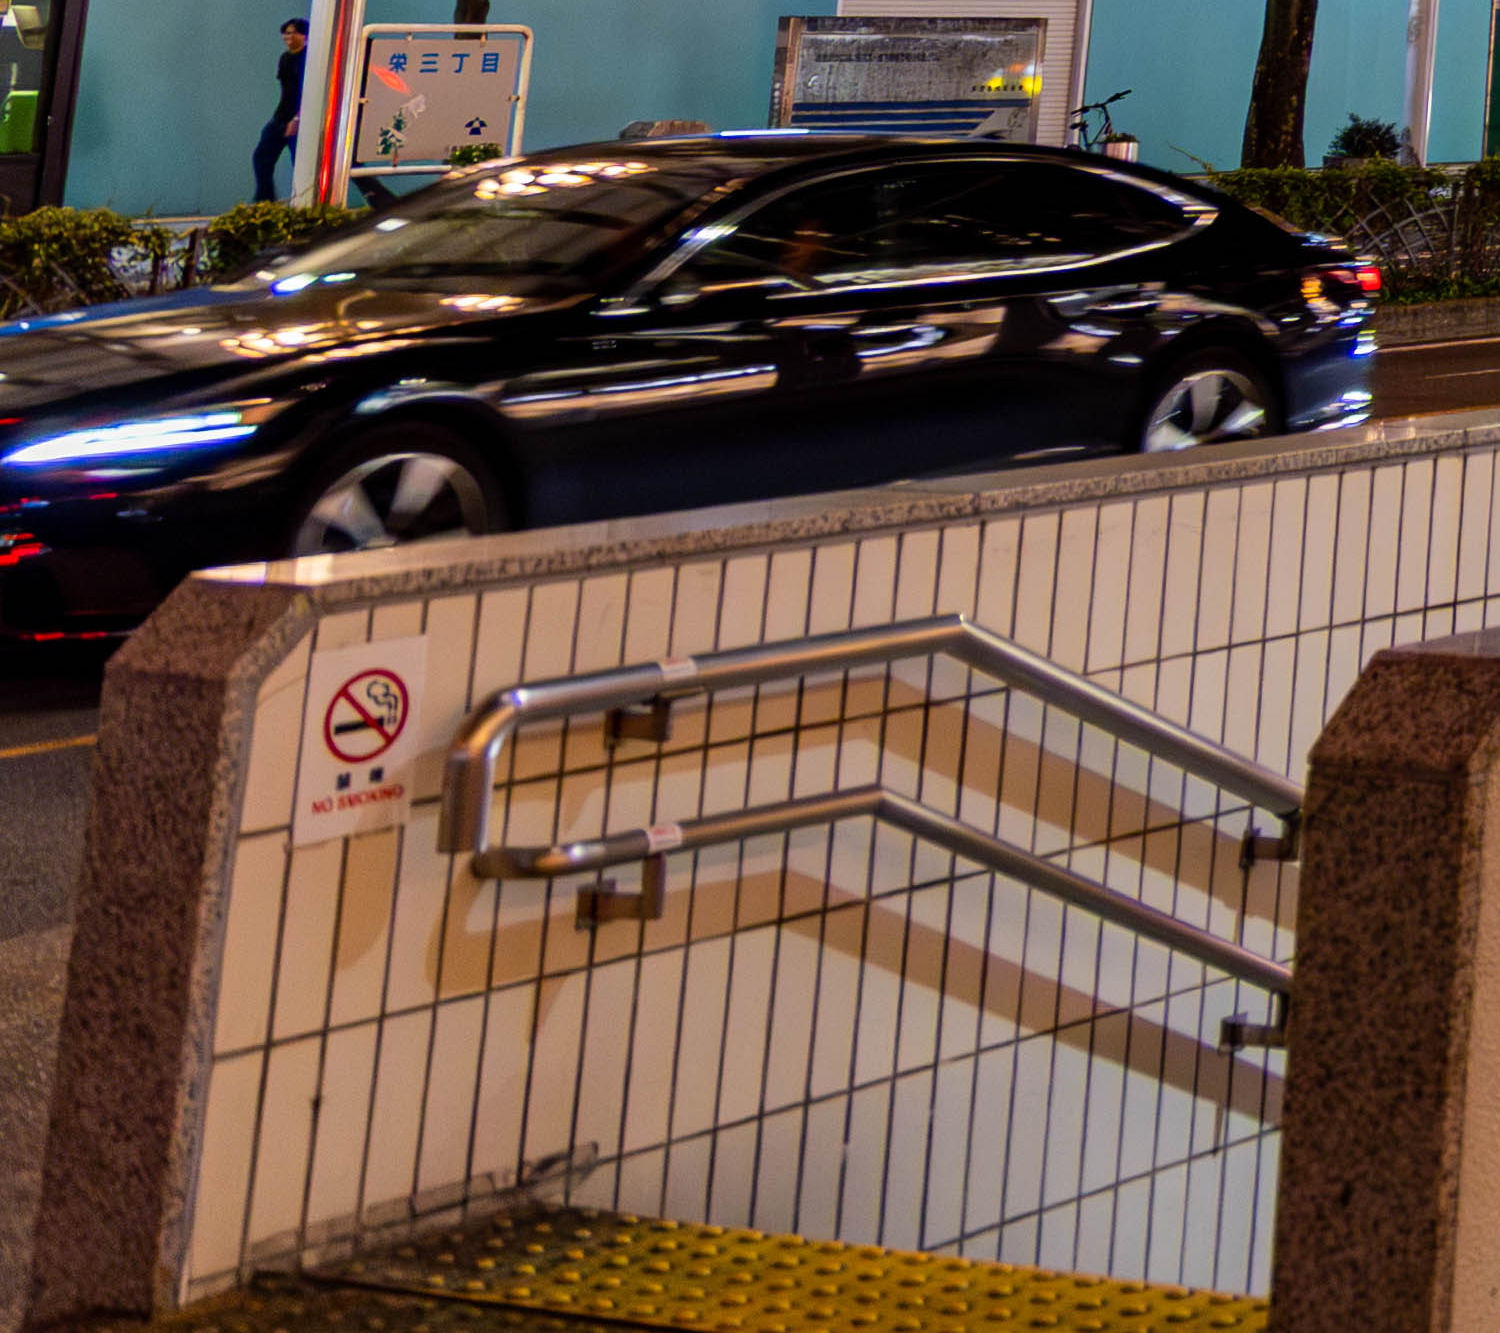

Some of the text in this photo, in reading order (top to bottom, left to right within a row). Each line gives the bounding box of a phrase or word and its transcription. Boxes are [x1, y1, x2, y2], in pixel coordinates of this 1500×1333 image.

[388, 52, 500, 73] 栄三丁目
[311, 784, 405, 815] NO SMOKING
